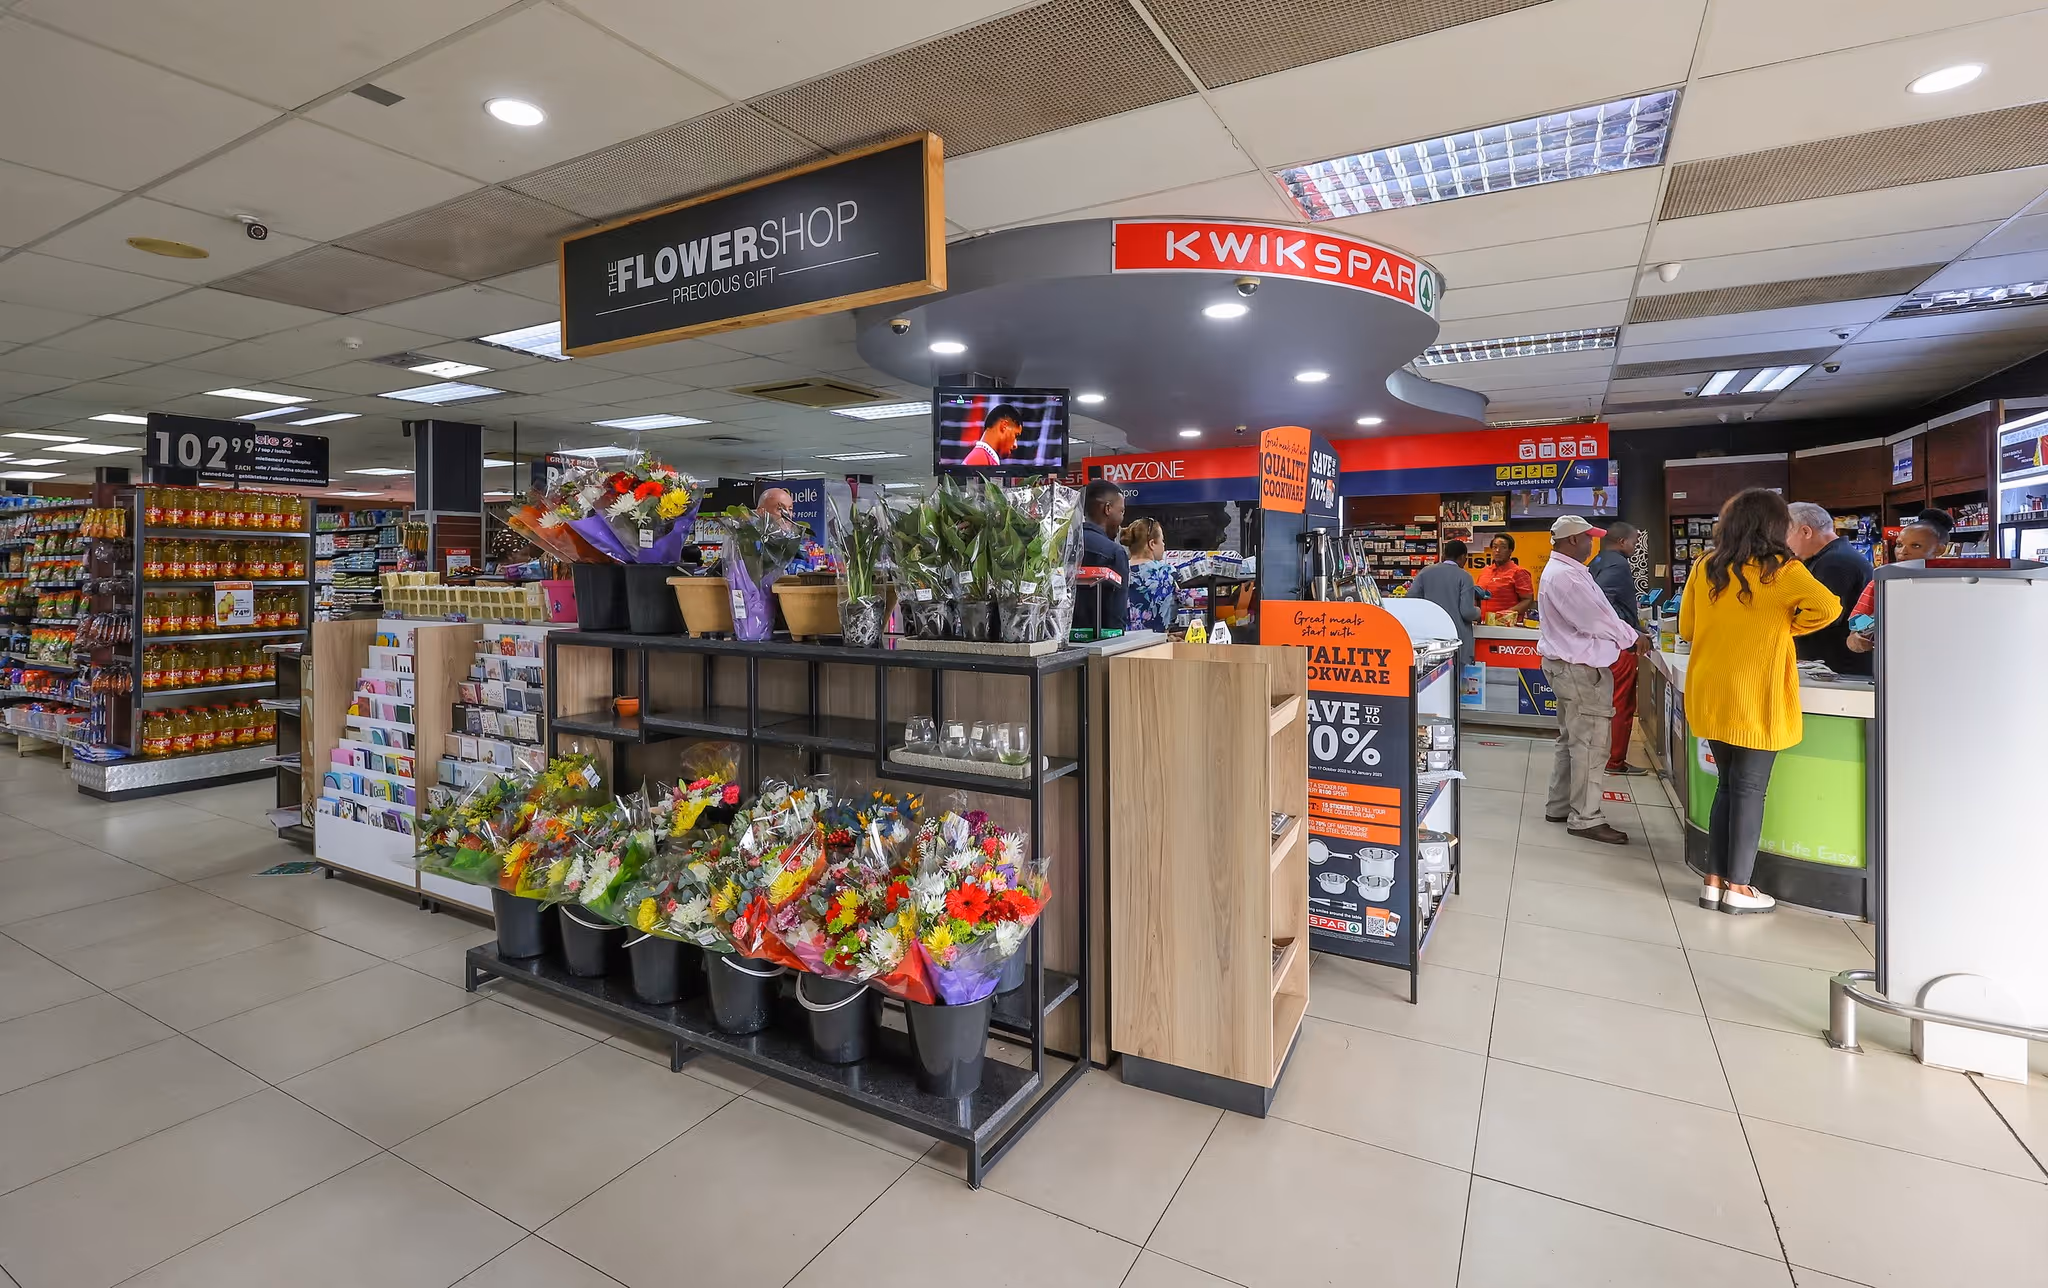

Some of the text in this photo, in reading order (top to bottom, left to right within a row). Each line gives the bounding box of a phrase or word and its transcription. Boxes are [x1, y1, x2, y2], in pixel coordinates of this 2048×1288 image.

[1166, 230, 1415, 298] KWIKSPAR
[607, 259, 618, 297] THE
[672, 266, 776, 304] PRECIOUS GIFT
[282, 437, 293, 448] 2
[1104, 460, 1185, 481] PAYZONE
[1264, 452, 1306, 482] QUALITY
[1311, 450, 1332, 478] SAVE
[1263, 478, 1304, 502] COOKWARE
[1294, 610, 1365, 626] Great meals
[1302, 625, 1356, 638] start with
[1308, 645, 1392, 668] ALITY
[1498, 645, 1541, 656] PAYZON
[1308, 666, 1391, 685] OKWARE
[1308, 699, 1381, 726] AVE UP
[1364, 715, 1380, 724] TO
[1308, 724, 1381, 766] 0%
[1329, 803, 1354, 811] STICKERS
[1334, 809, 1362, 818] COLLECTOR
[1782, 840, 1811, 857] Life
[1818, 845, 1857, 865] Easy
[1309, 916, 1347, 931] SPAR
